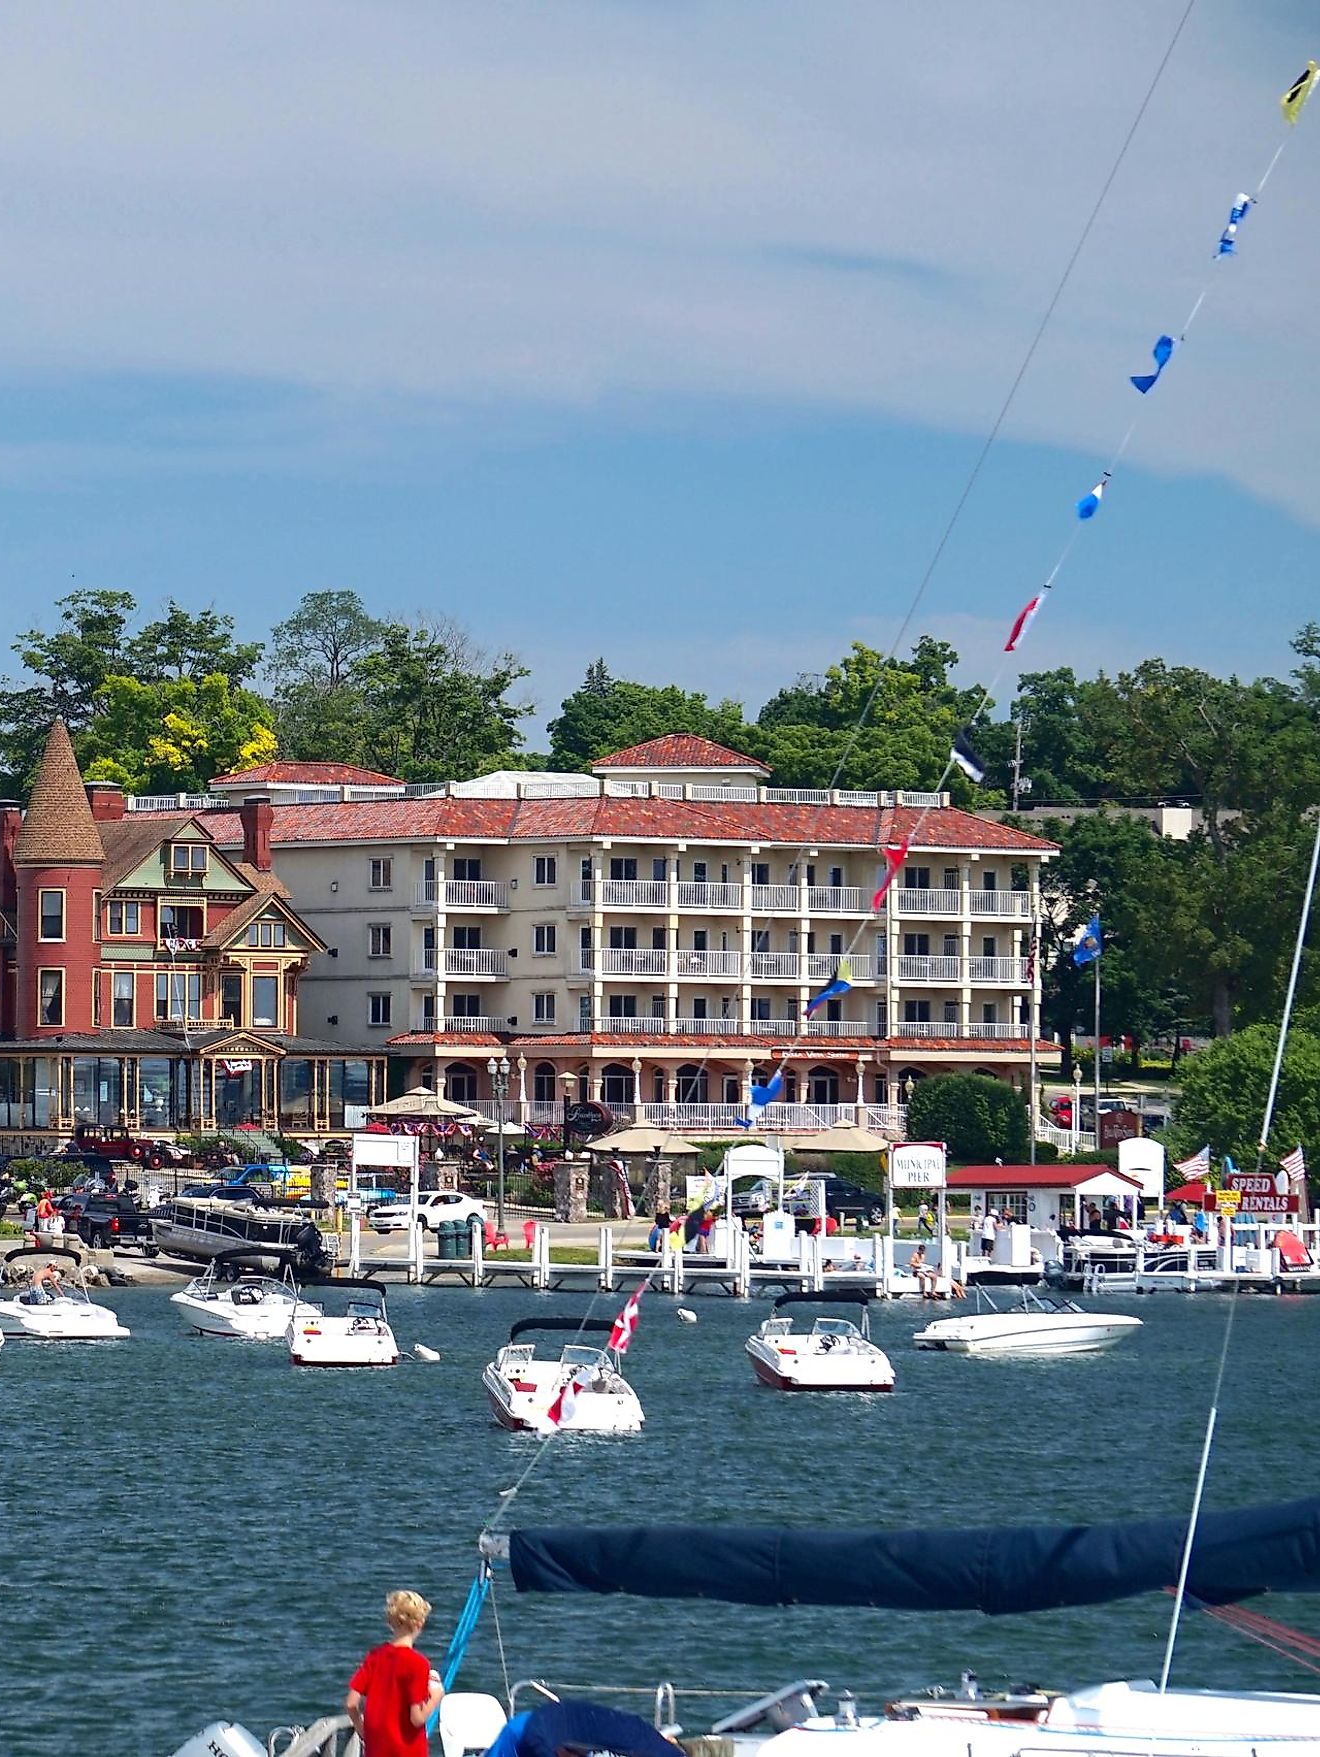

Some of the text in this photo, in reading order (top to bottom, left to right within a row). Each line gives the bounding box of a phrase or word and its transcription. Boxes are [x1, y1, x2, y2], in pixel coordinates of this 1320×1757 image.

[896, 1159, 941, 1170] MUNICIPAL
[908, 1172, 930, 1183] PIER
[1231, 1178, 1271, 1193] SPEED
[1242, 1196, 1289, 1211] RENTALS
